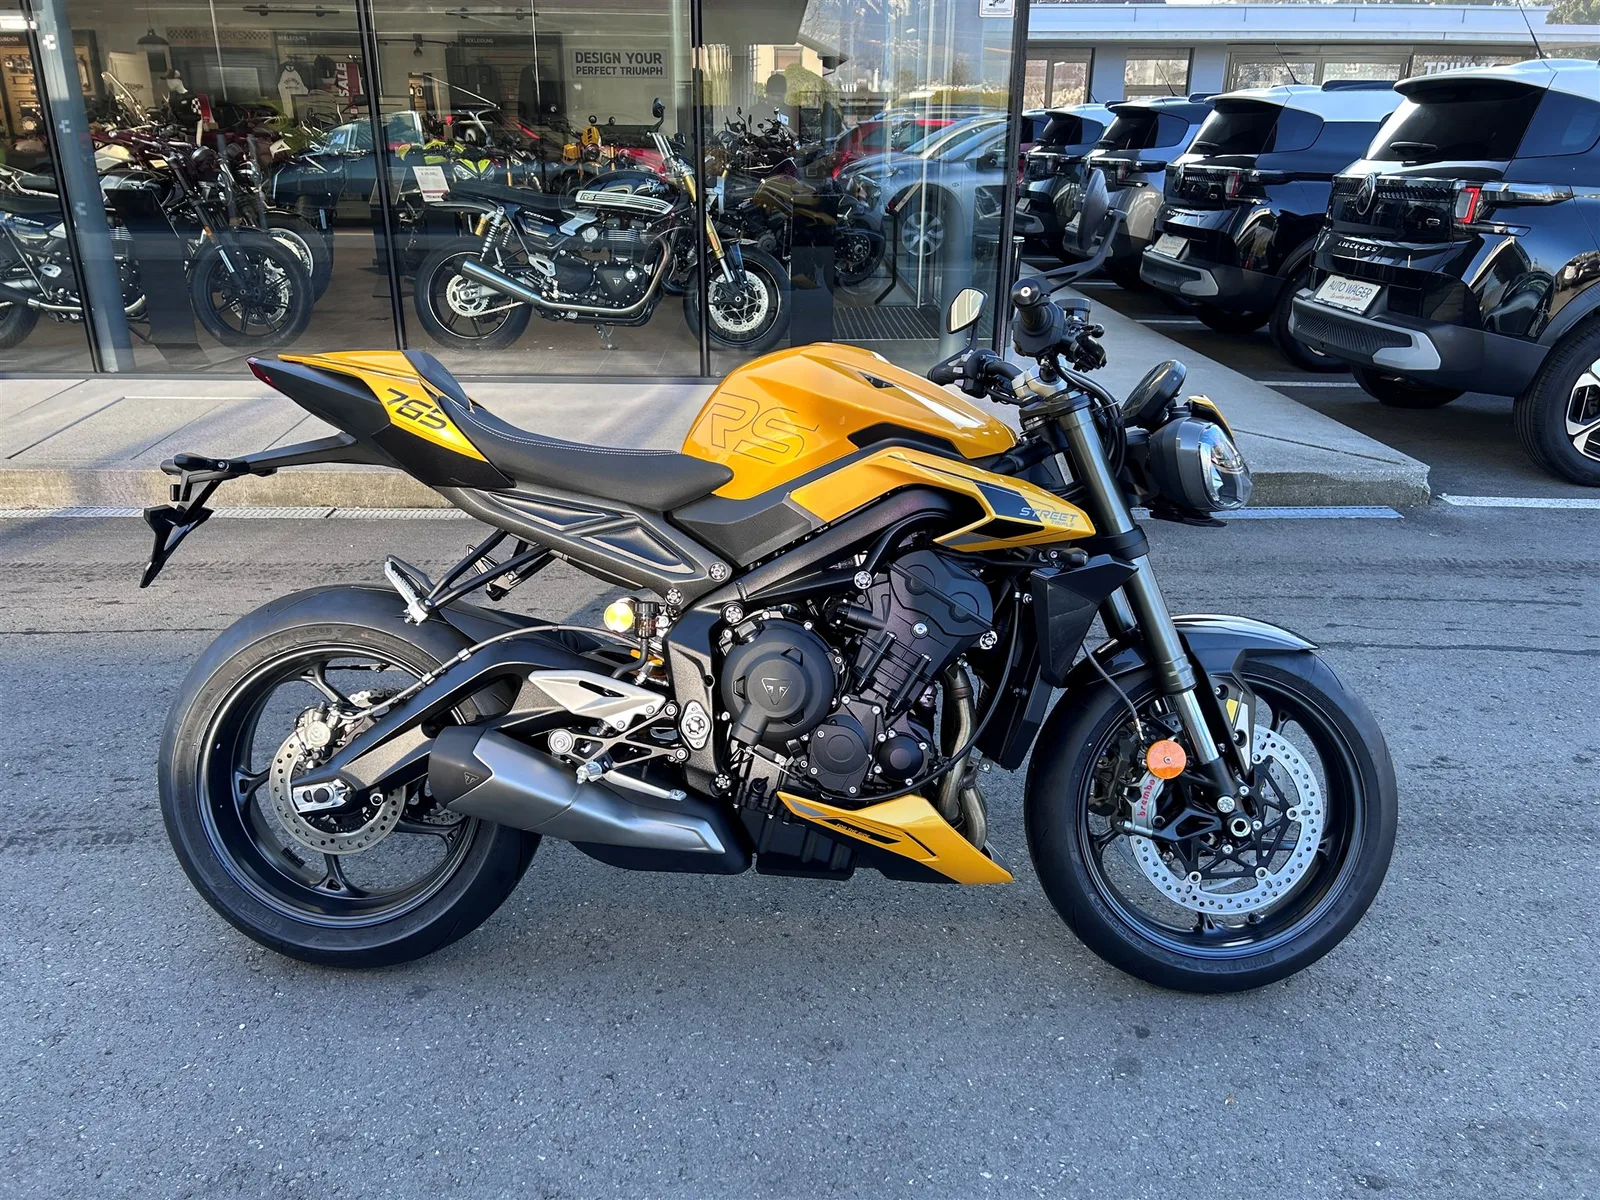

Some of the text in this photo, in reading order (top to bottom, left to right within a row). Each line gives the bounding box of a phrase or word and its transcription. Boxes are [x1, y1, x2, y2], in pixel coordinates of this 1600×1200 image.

[575, 52, 662, 64] DESIGN YOUR
[576, 66, 663, 75] PERFECT TRIUMPH
[336, 62, 349, 97] SALE
[1338, 241, 1378, 252] AIRCROSS
[1327, 280, 1346, 292] AUTO
[387, 388, 447, 429] 765
[690, 391, 820, 465] RS
[1019, 507, 1078, 521] STREET
[1137, 779, 1156, 817] brembo
